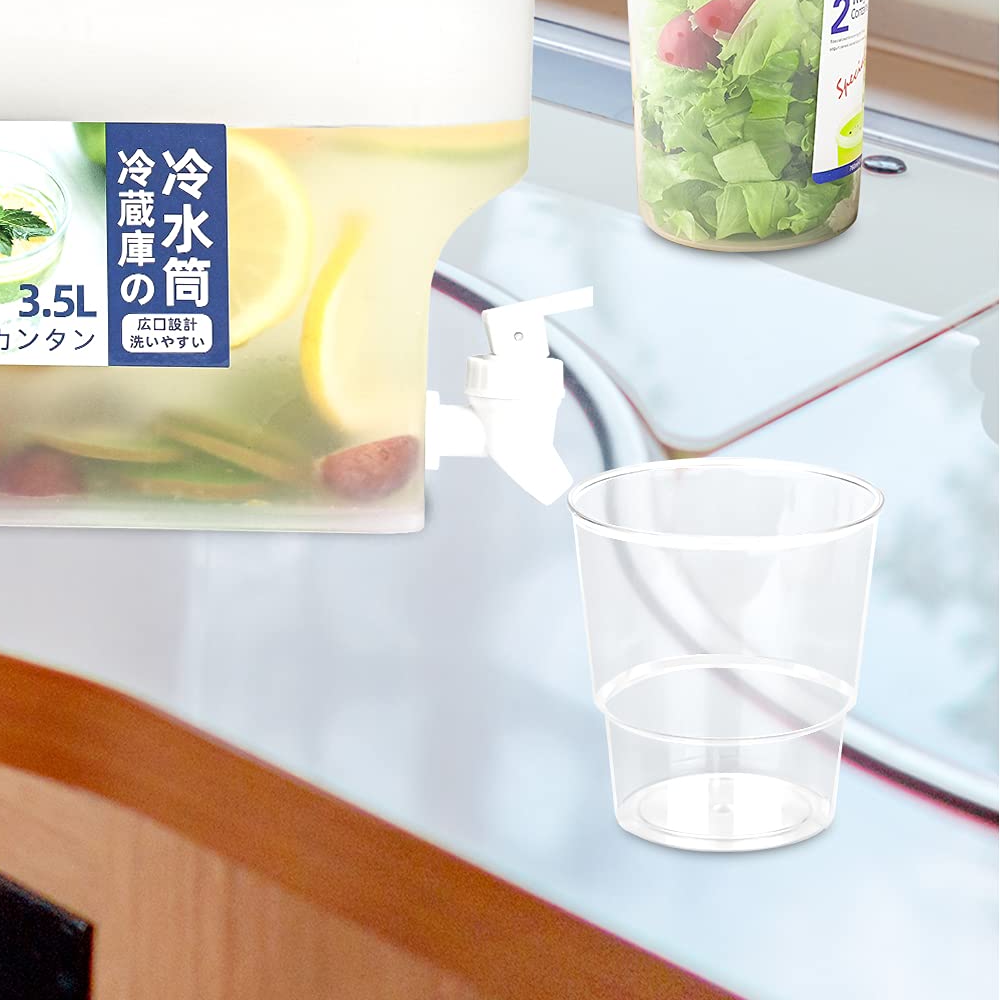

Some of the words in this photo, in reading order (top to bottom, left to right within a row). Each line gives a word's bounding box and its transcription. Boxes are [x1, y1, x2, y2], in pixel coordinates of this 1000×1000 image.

[117, 148, 156, 306] 冷蔵庫の
[161, 148, 214, 308] 冷水筒
[18, 283, 98, 318] 3.5L
[137, 317, 198, 331] 広口設計
[130, 335, 205, 349] 洗いやすい
